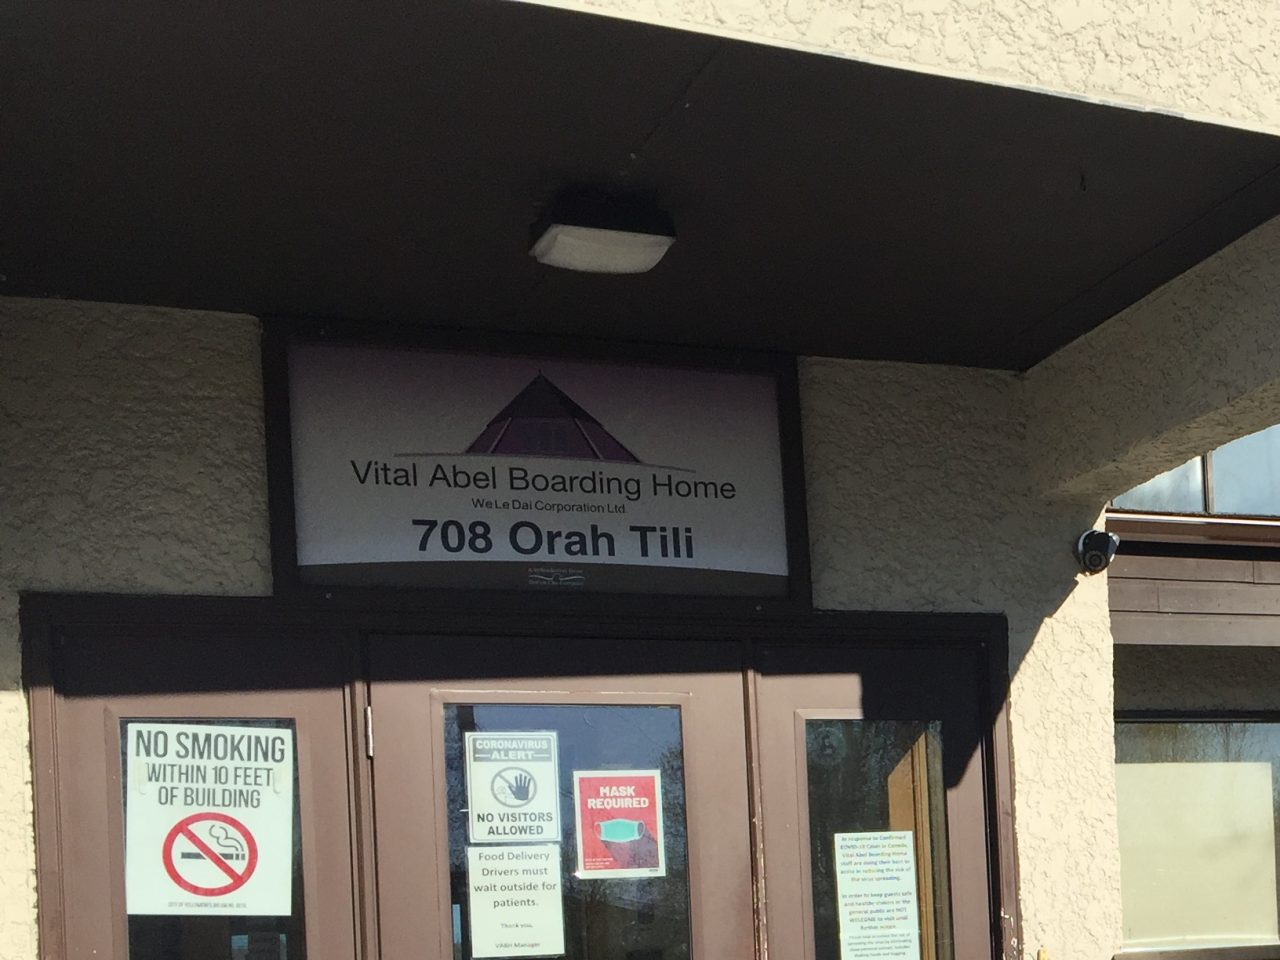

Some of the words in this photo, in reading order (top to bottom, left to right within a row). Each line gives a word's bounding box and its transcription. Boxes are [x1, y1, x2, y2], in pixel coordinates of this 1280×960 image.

[350, 460, 418, 487] Vital
[428, 464, 496, 490] Abel
[509, 467, 642, 501] Boarding
[652, 474, 737, 500] Home
[471, 498, 493, 509] We
[494, 499, 510, 510] Le
[511, 499, 533, 511] Dai
[534, 500, 605, 514] Corporation
[412, 519, 494, 554] 708
[509, 521, 617, 557] Orah
[629, 525, 695, 559] Tili
[135, 729, 169, 758] NO
[176, 731, 286, 763] SMOKING
[476, 739, 548, 749] CORONAVIRUS
[491, 751, 534, 760] ALERT
[146, 763, 207, 784] WITHIN
[212, 765, 229, 785] 10
[233, 766, 274, 786] FEET
[600, 786, 635, 797] MASK
[158, 786, 179, 806] OF
[184, 787, 261, 809] BUILDING
[587, 798, 649, 808] REQUIRED
[477, 813, 494, 823] NO
[498, 812, 553, 822] VISITORS
[488, 825, 544, 835] ALLOWED
[479, 852, 504, 861] Food
[507, 851, 550, 861] Delivery
[482, 867, 519, 876] Drivers
[522, 867, 548, 875] must
[474, 883, 497, 892] wait
[500, 882, 539, 891] outside
[542, 882, 557, 891] for
[493, 898, 539, 909] patients.
